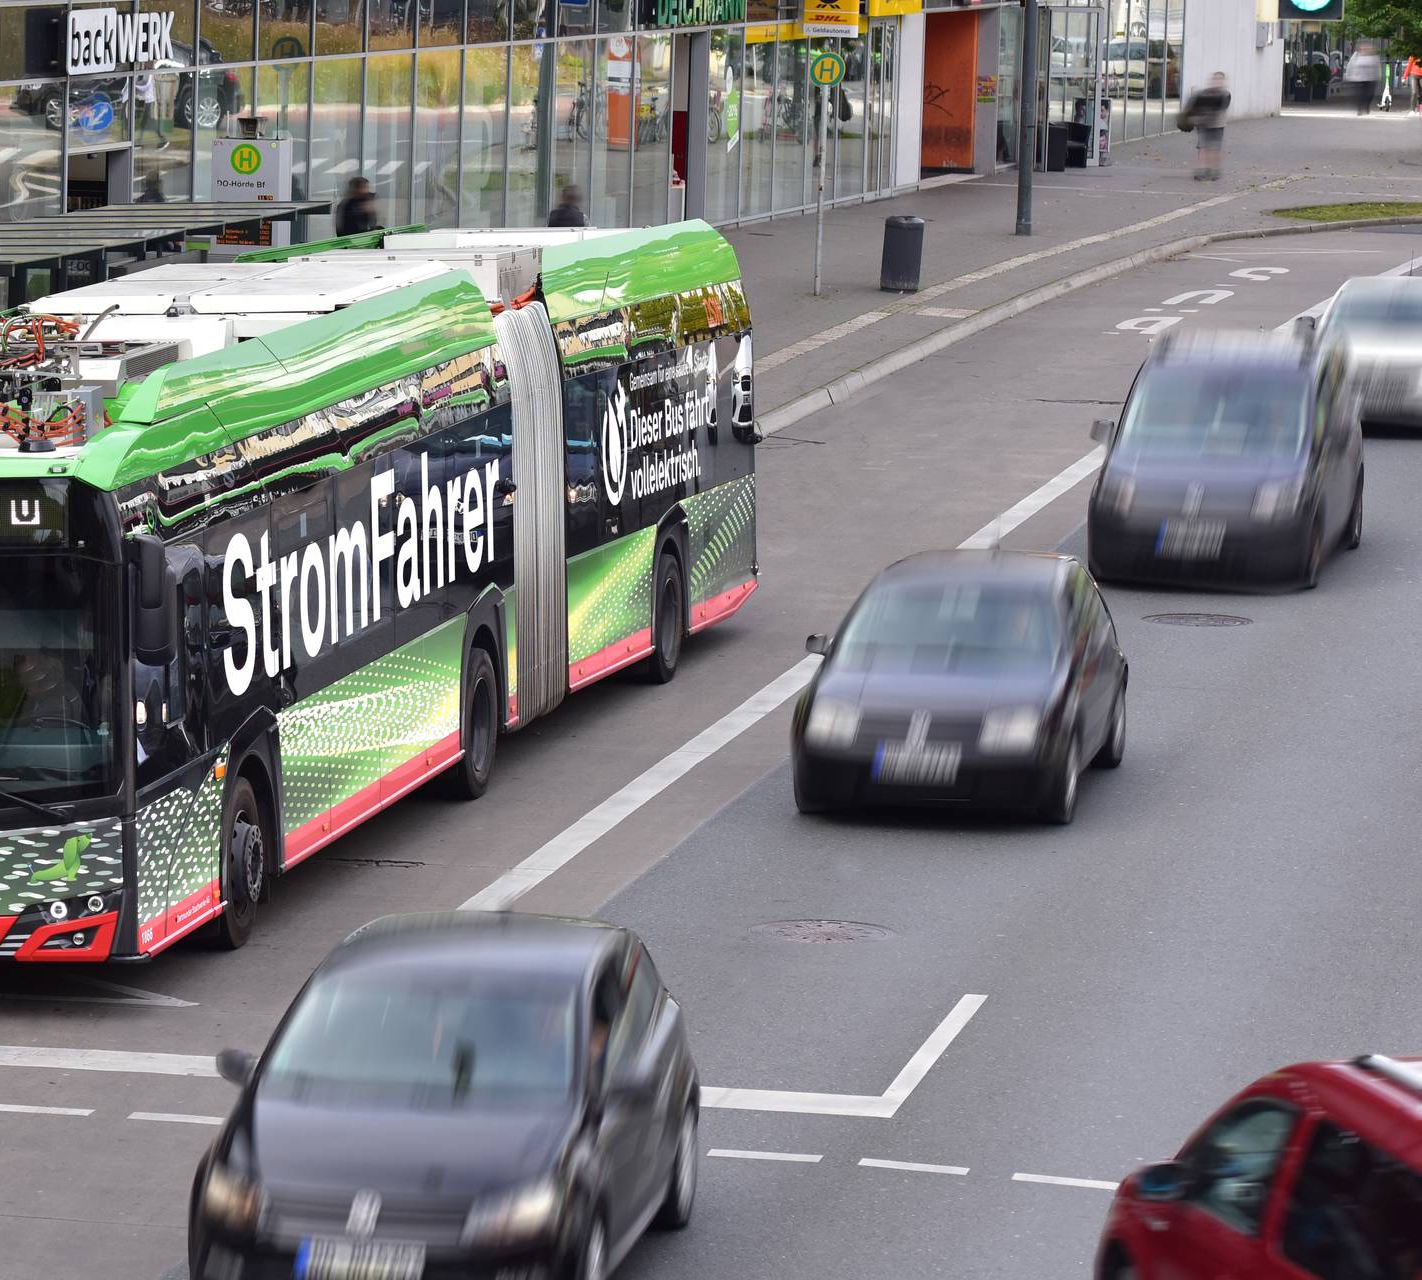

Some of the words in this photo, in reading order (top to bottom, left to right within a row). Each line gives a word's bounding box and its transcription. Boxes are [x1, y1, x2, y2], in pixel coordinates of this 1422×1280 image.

[630, 407, 662, 450] Dieser
[665, 399, 683, 437] Bus
[685, 389, 710, 431] fährt
[630, 440, 702, 500] vollelektrisch.
[222, 451, 500, 696] StromFahrer
